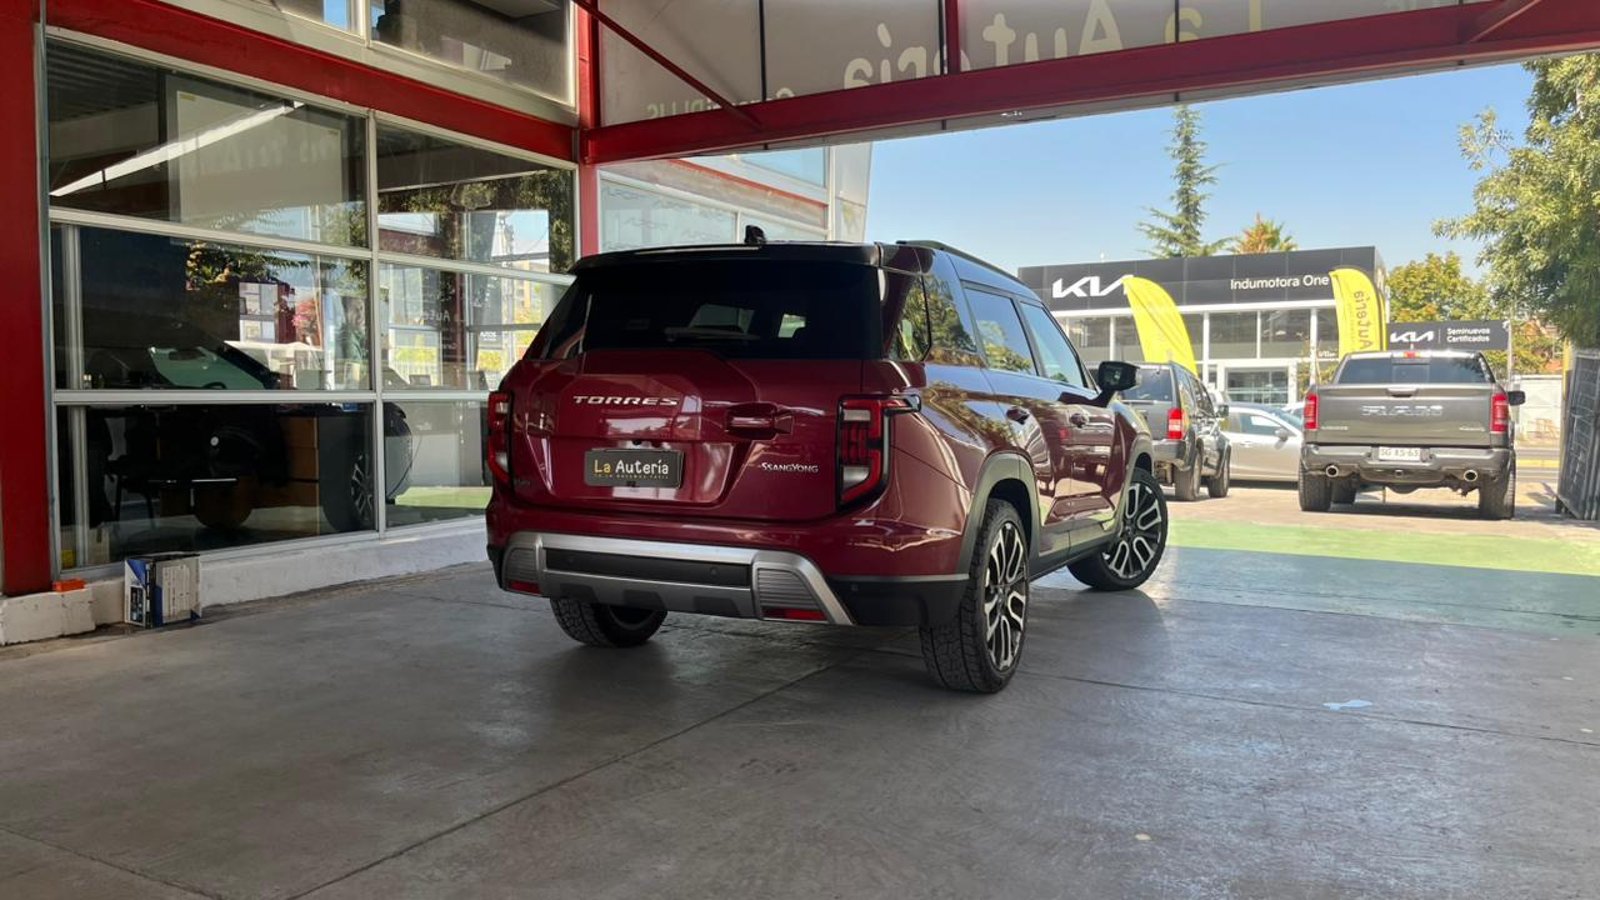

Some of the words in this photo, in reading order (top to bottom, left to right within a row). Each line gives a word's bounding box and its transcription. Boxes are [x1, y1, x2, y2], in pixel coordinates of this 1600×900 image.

[1052, 274, 1134, 298] KIA
[1230, 278, 1300, 290] Indumotora
[1302, 274, 1329, 287] One
[1390, 331, 1435, 342] KIA
[1446, 327, 1490, 335] Seminuevos
[573, 395, 679, 405] TORRES
[594, 459, 612, 473] La
[615, 459, 669, 475] Autería
